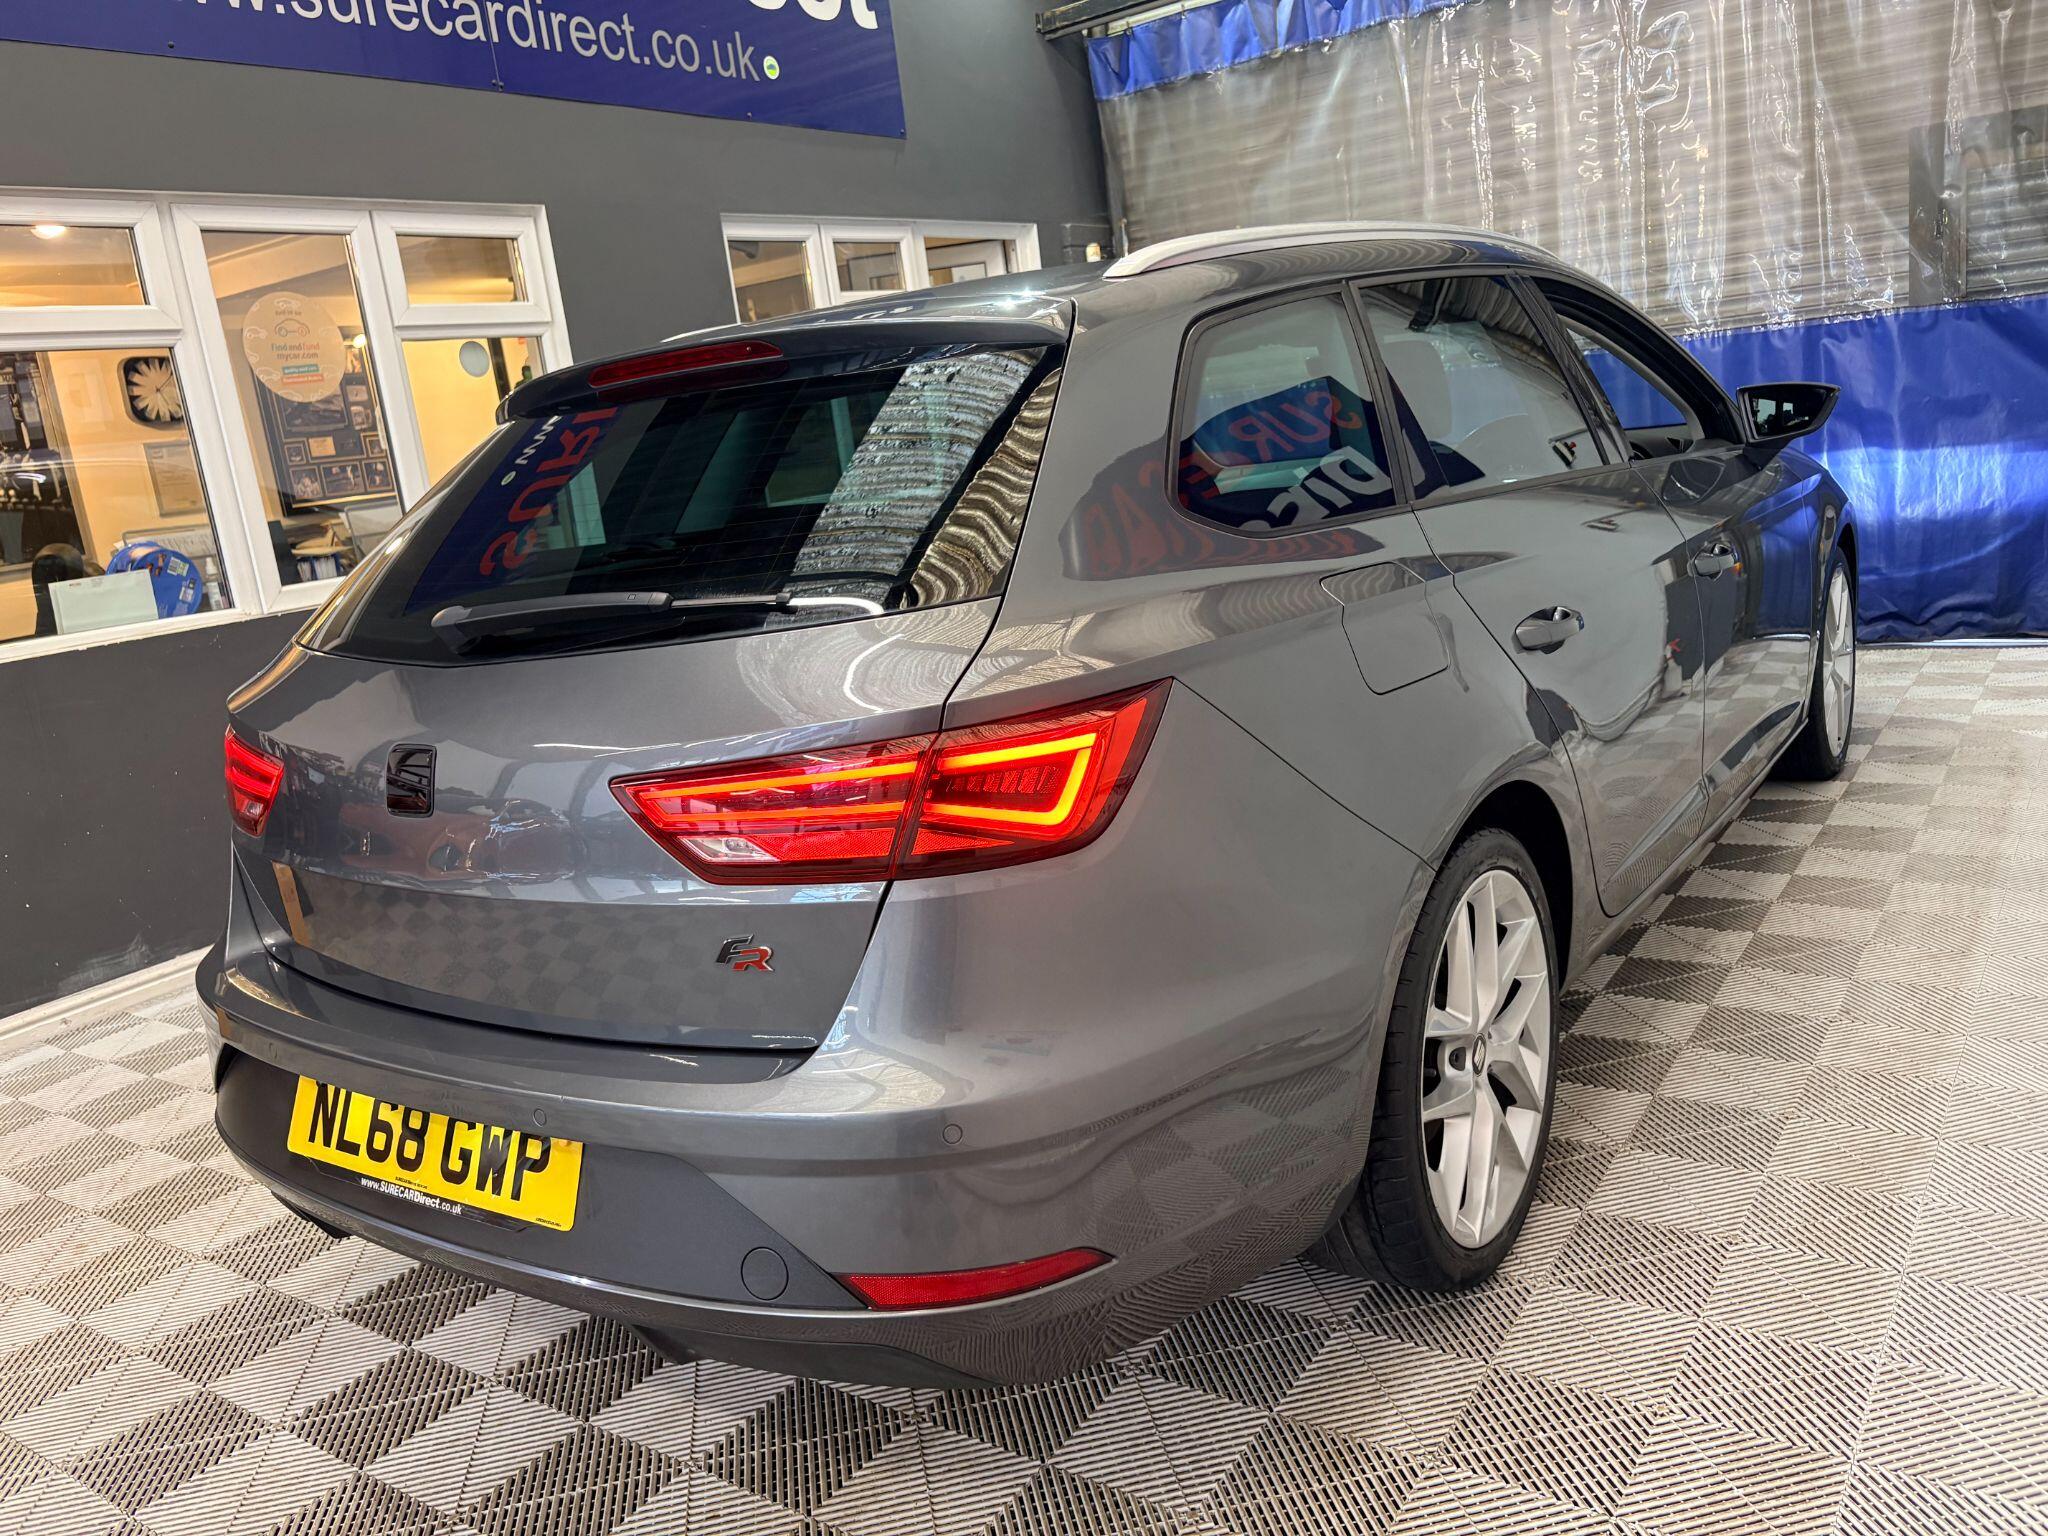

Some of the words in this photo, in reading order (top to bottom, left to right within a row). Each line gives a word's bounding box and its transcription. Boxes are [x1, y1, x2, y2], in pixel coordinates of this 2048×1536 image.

[715, 933, 776, 972] FR
[307, 1081, 431, 1173] NL68
[440, 1117, 552, 1202] GWP
[360, 1176, 463, 1216] www.SURECARDirect.co.uk
